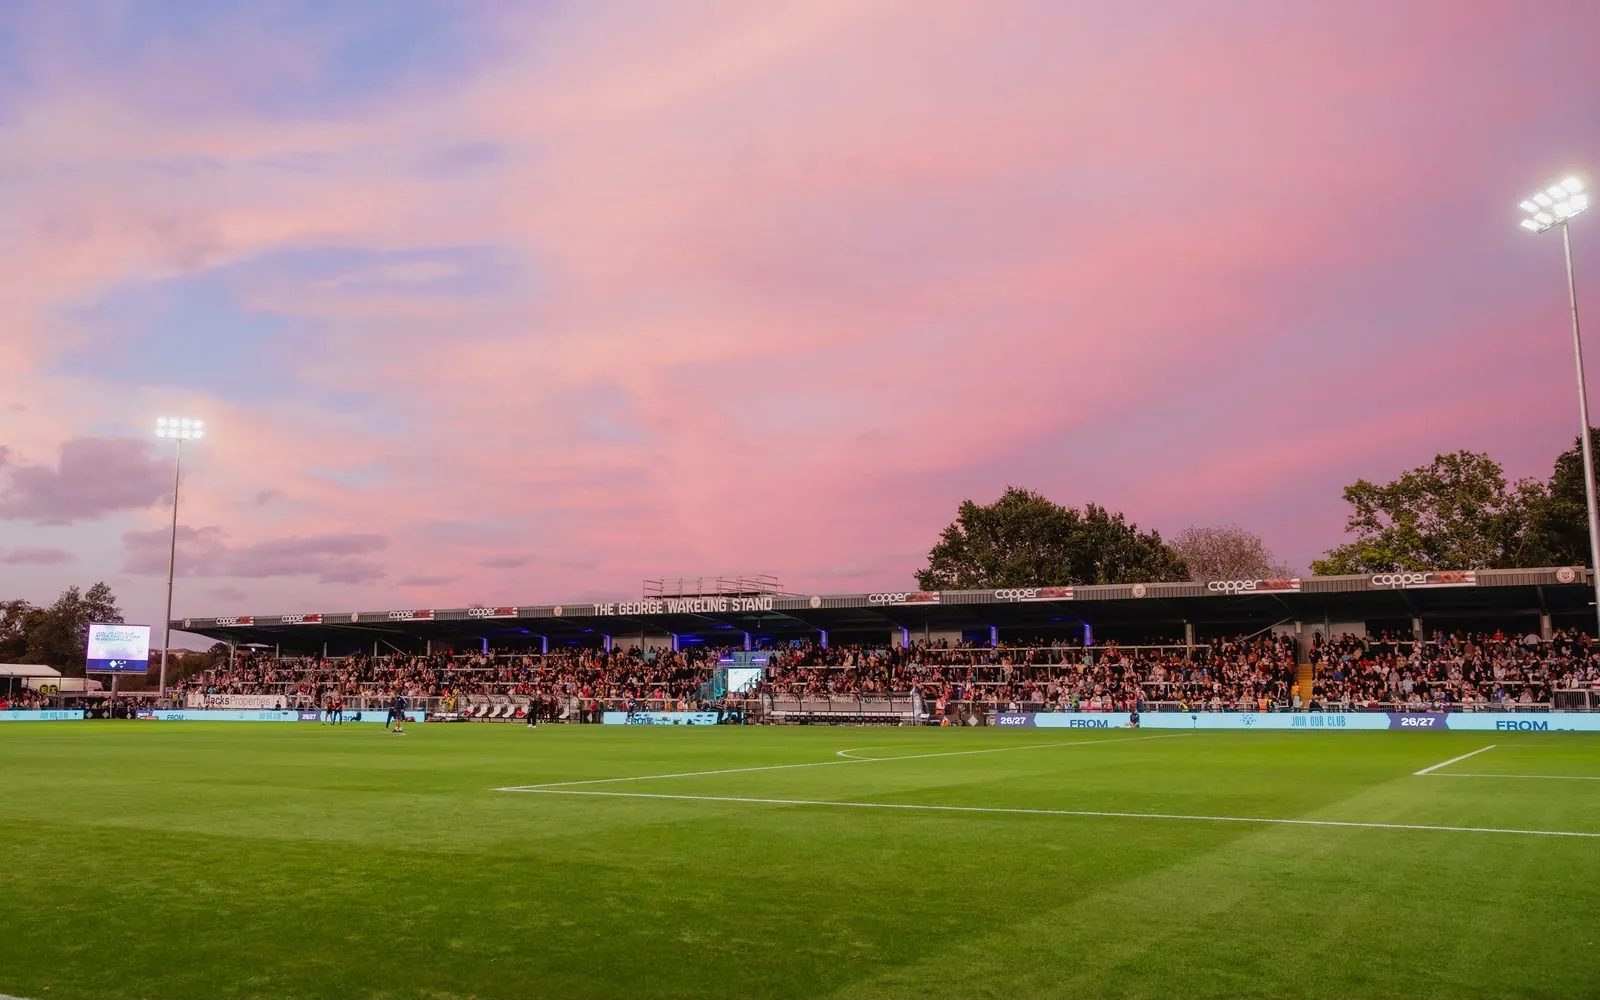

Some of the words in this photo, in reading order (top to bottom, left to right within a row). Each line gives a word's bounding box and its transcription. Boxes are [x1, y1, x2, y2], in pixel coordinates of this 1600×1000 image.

[593, 603, 615, 616] THE
[618, 601, 663, 616] GEORGE
[667, 599, 727, 614] WAKELING
[732, 597, 773, 611] STAND
[1000, 717, 1026, 725] 26/27
[1069, 719, 1108, 728] FROM
[1291, 715, 1307, 727] JOIN
[1310, 715, 1324, 727] OUR
[1327, 715, 1346, 727] CLUB
[1401, 717, 1435, 727] 26/27
[1496, 720, 1548, 731] FROM
